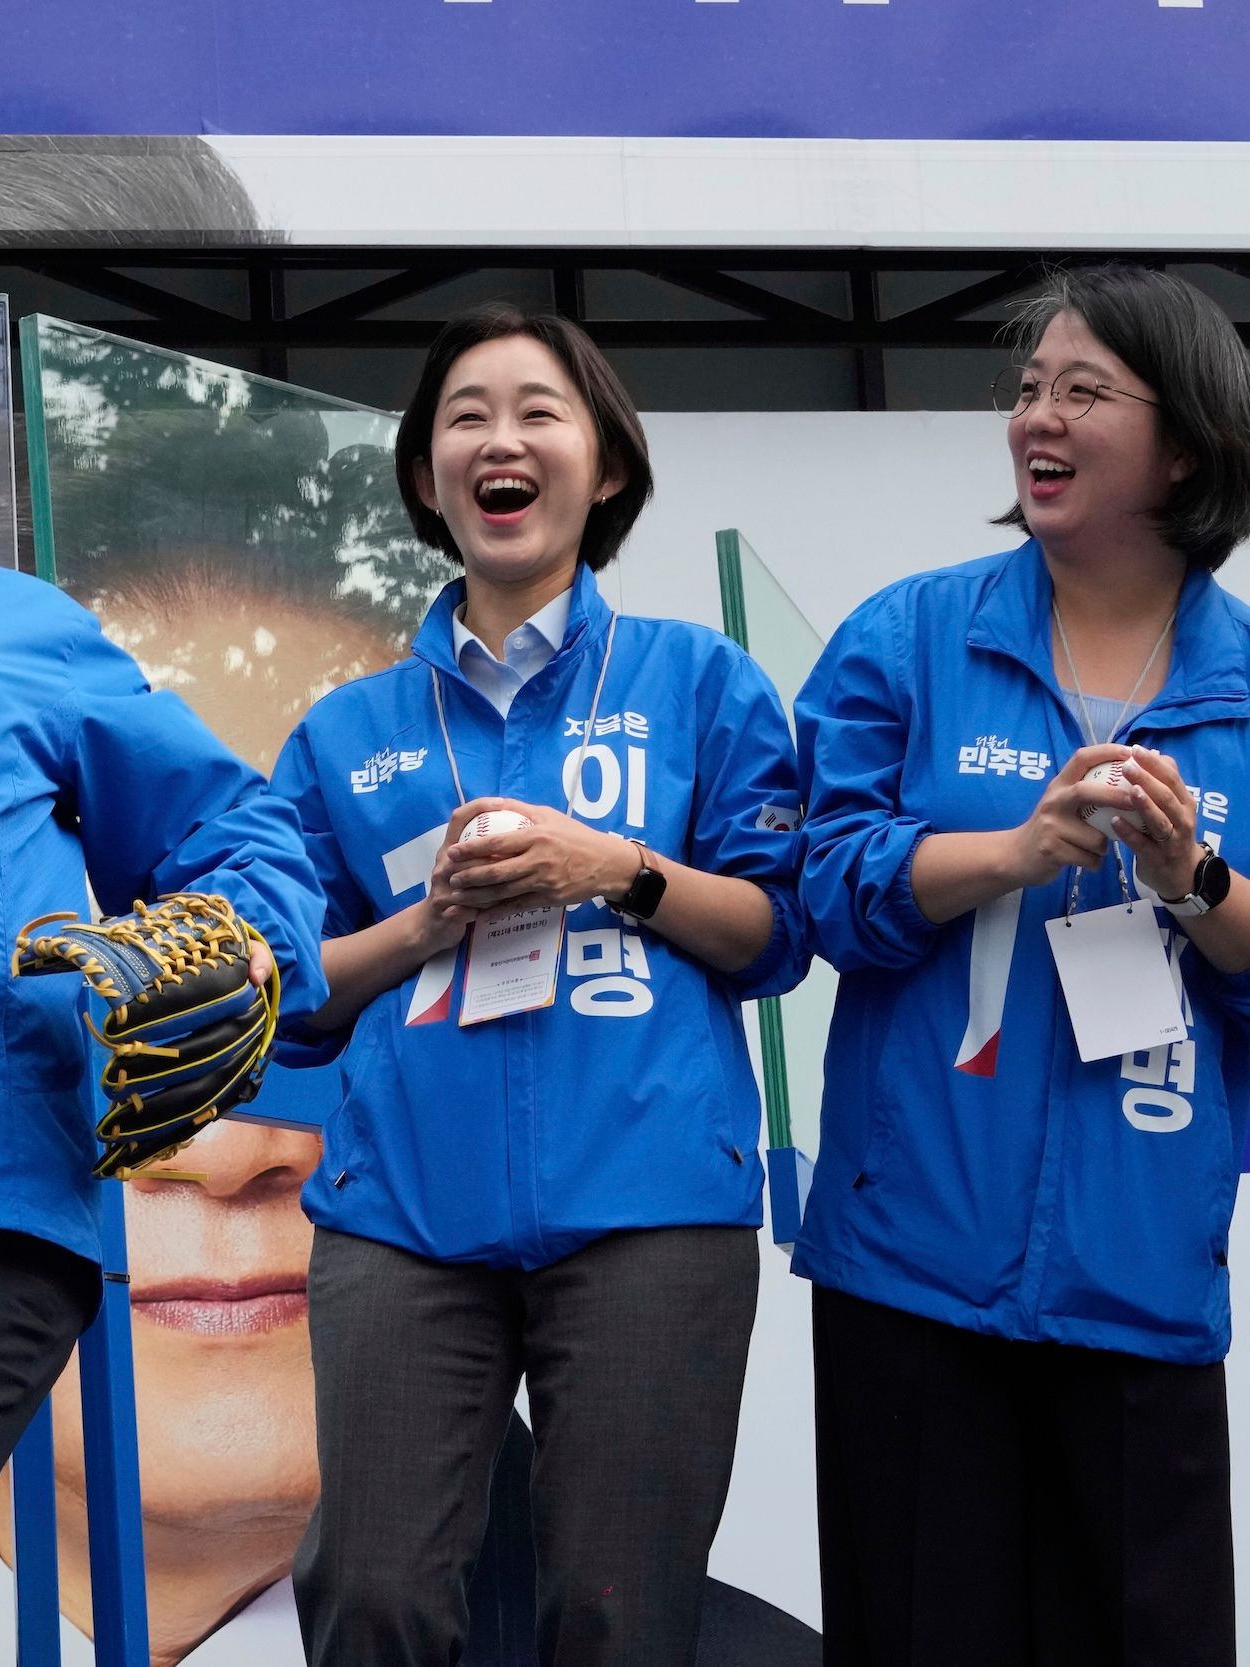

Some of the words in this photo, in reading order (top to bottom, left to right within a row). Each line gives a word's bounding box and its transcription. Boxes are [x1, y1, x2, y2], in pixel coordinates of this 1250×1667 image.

[564, 711, 649, 739] 지금은
[975, 734, 1009, 750] 더불어
[350, 747, 428, 794] 민주당
[958, 746, 1051, 780] 민주당
[562, 744, 654, 1018] 이명
